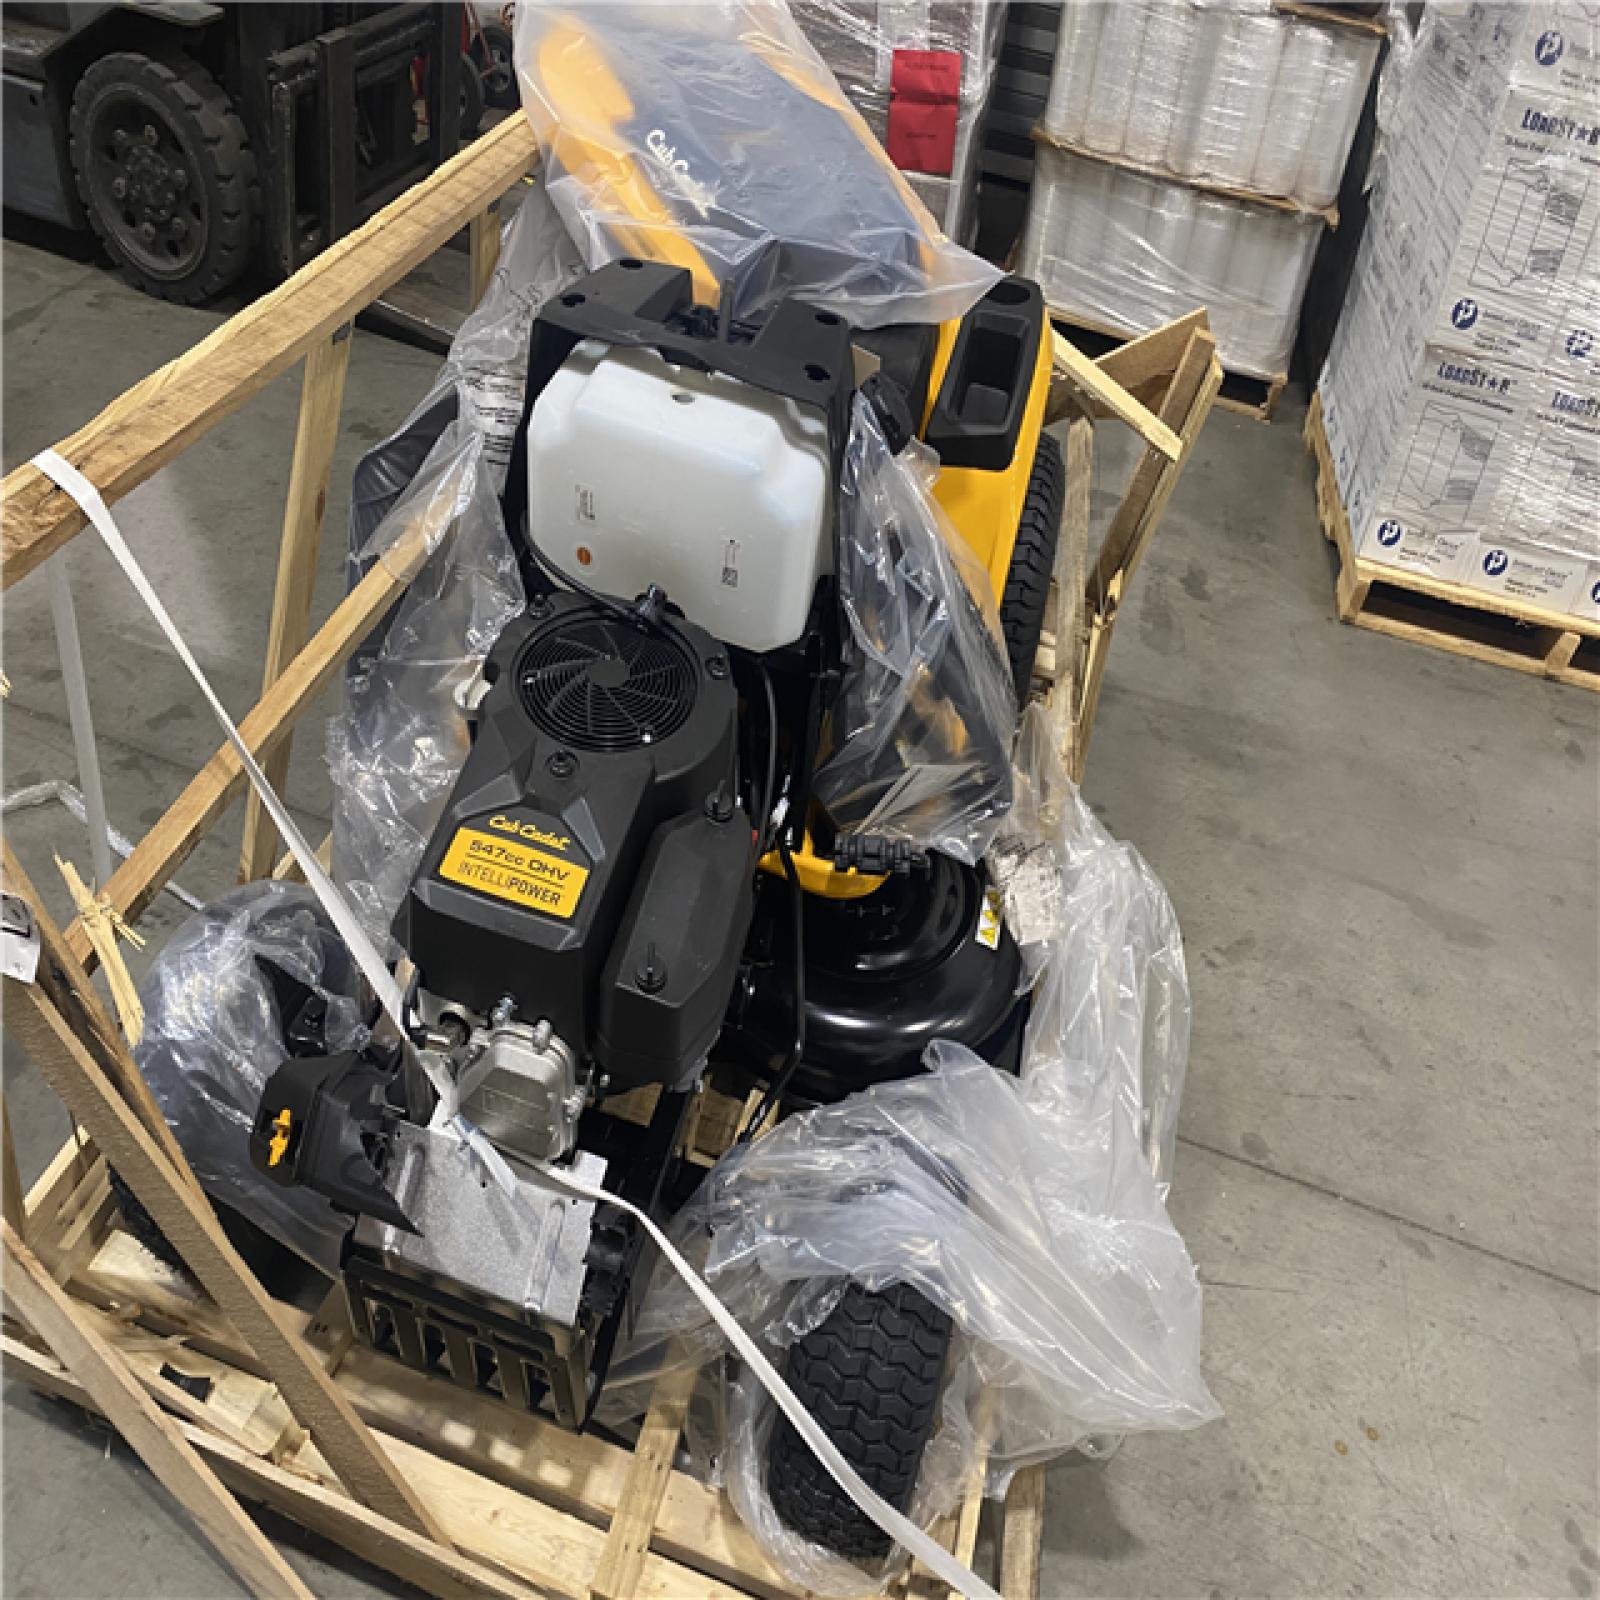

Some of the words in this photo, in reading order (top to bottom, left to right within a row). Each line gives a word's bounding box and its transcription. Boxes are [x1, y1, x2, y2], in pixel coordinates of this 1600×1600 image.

[489, 815, 520, 833] Cub
[519, 824, 571, 851] Cadet
[469, 840, 525, 866] 547cc
[528, 859, 570, 881] OHV
[458, 860, 562, 906] INTELLIPOWER
